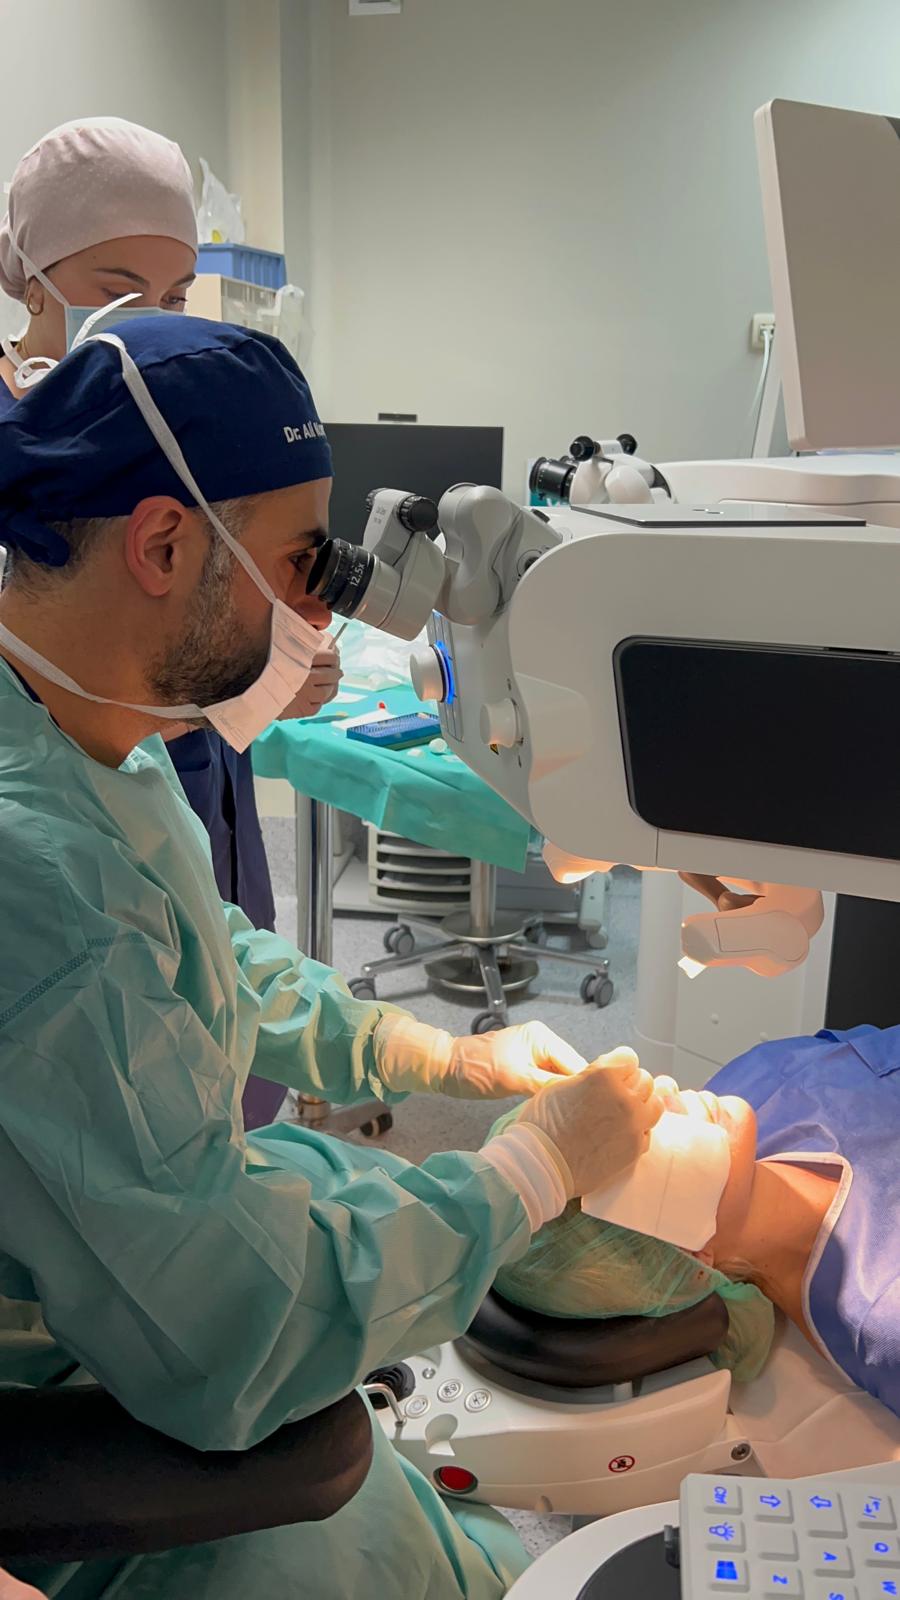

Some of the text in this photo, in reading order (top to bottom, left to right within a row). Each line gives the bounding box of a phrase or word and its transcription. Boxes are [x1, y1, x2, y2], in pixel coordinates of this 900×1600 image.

[283, 426, 302, 443] Dr.
[351, 563, 366, 587] 12.5x
[823, 1551, 837, 1561] A
[773, 1574, 788, 1584] Z
[881, 1581, 897, 1596] W
